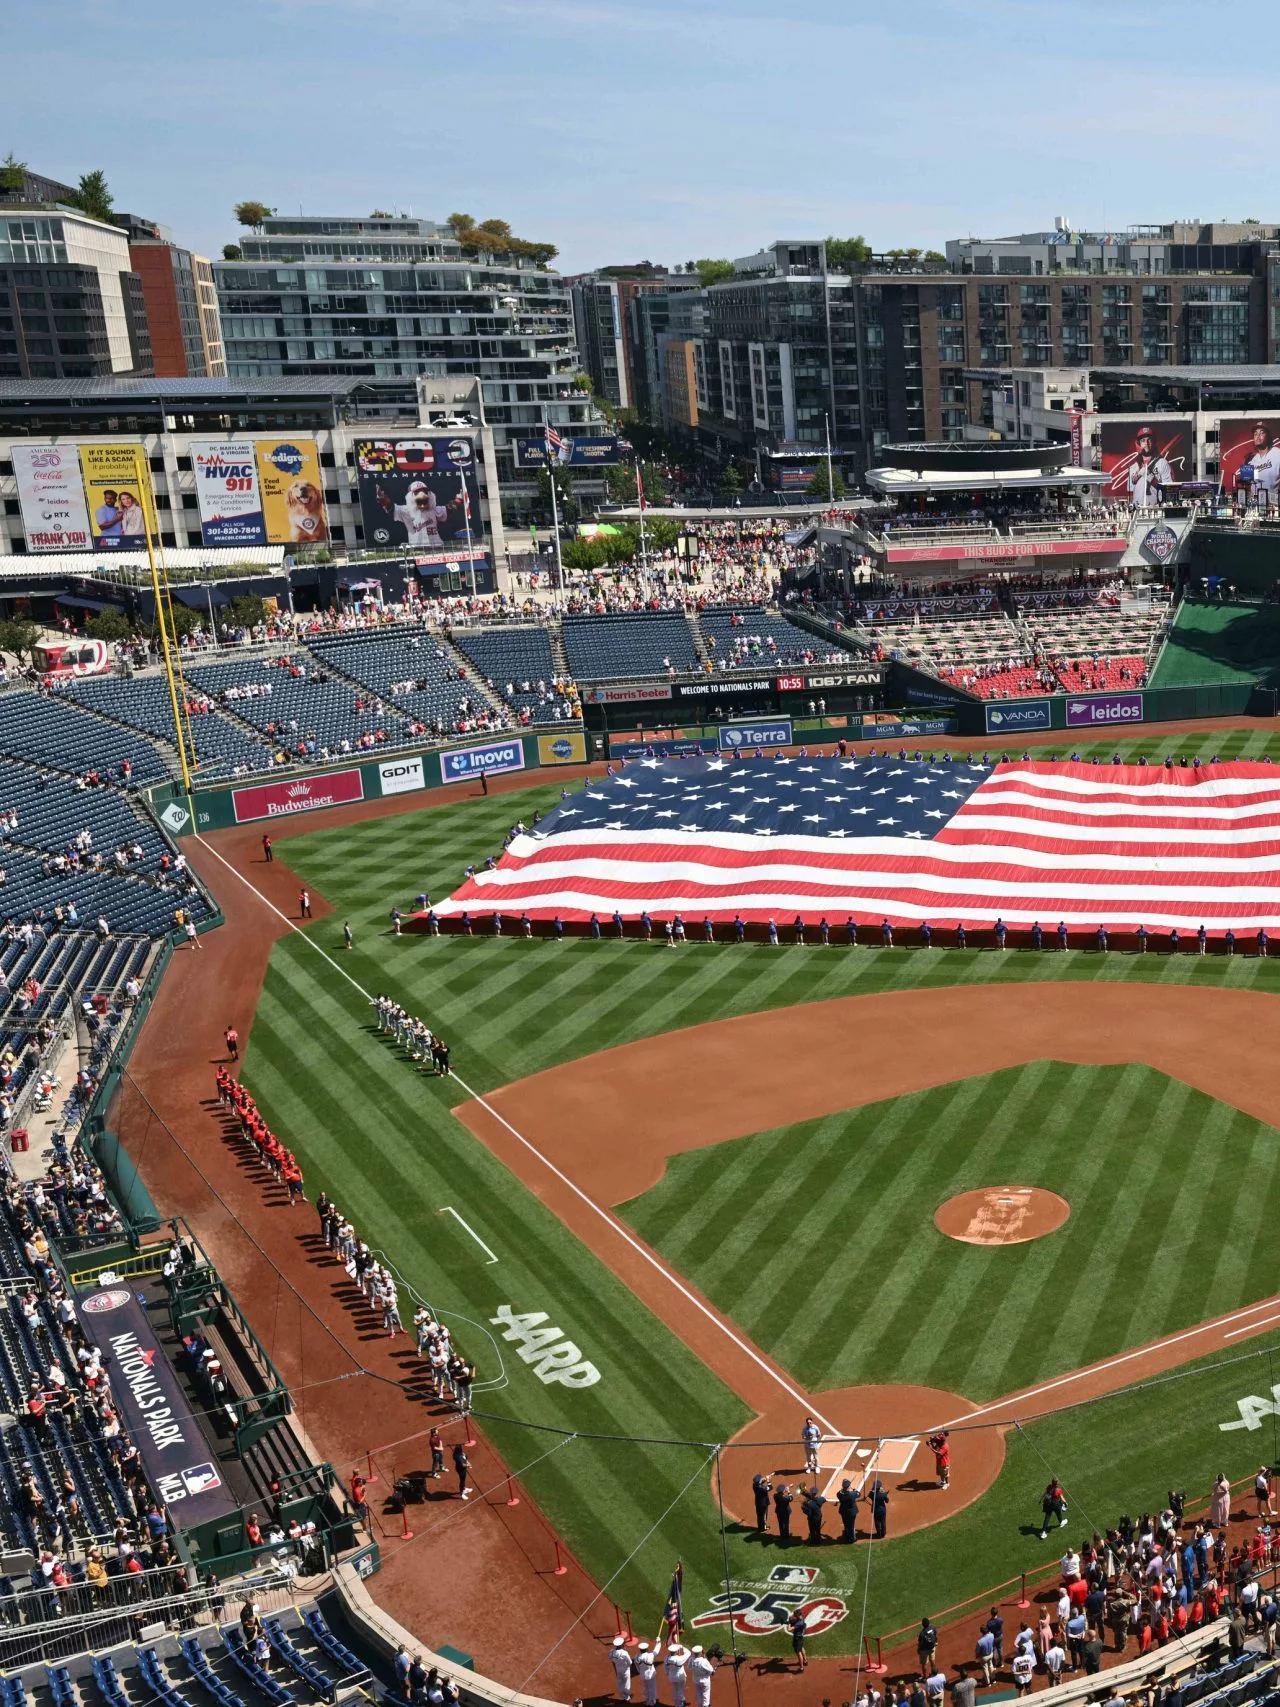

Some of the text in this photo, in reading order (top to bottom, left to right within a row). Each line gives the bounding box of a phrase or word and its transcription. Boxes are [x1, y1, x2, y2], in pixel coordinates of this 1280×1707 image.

[264, 452, 310, 464] Pedigree
[205, 465, 252, 478] HVAC
[226, 478, 252, 492] 911
[208, 527, 260, 536] 301-820-7848
[31, 532, 86, 545] THANK YOU
[964, 544, 1056, 557] THIS BUD'S FOR YOU.
[780, 678, 802, 690] 10:55
[847, 674, 881, 684] FAN
[606, 688, 670, 701] Harris Teeter
[680, 681, 770, 695] WELCOME TO NATIONALS PARK
[1004, 710, 1046, 720] VANDA
[1091, 703, 1140, 720] leidos
[852, 716, 861, 725] 377
[743, 728, 786, 744] Terra
[548, 744, 576, 753] Pedigree
[470, 748, 514, 766] Inova
[382, 764, 420, 778] GDIT
[267, 794, 334, 815] Budweiser
[199, 813, 210, 824] 336
[489, 1304, 602, 1388] AARP
[108, 1331, 185, 1451] NATIONALS PARK
[156, 1472, 188, 1504] MLB
[720, 1580, 854, 1596] CELEBRATING AMERICA'S
